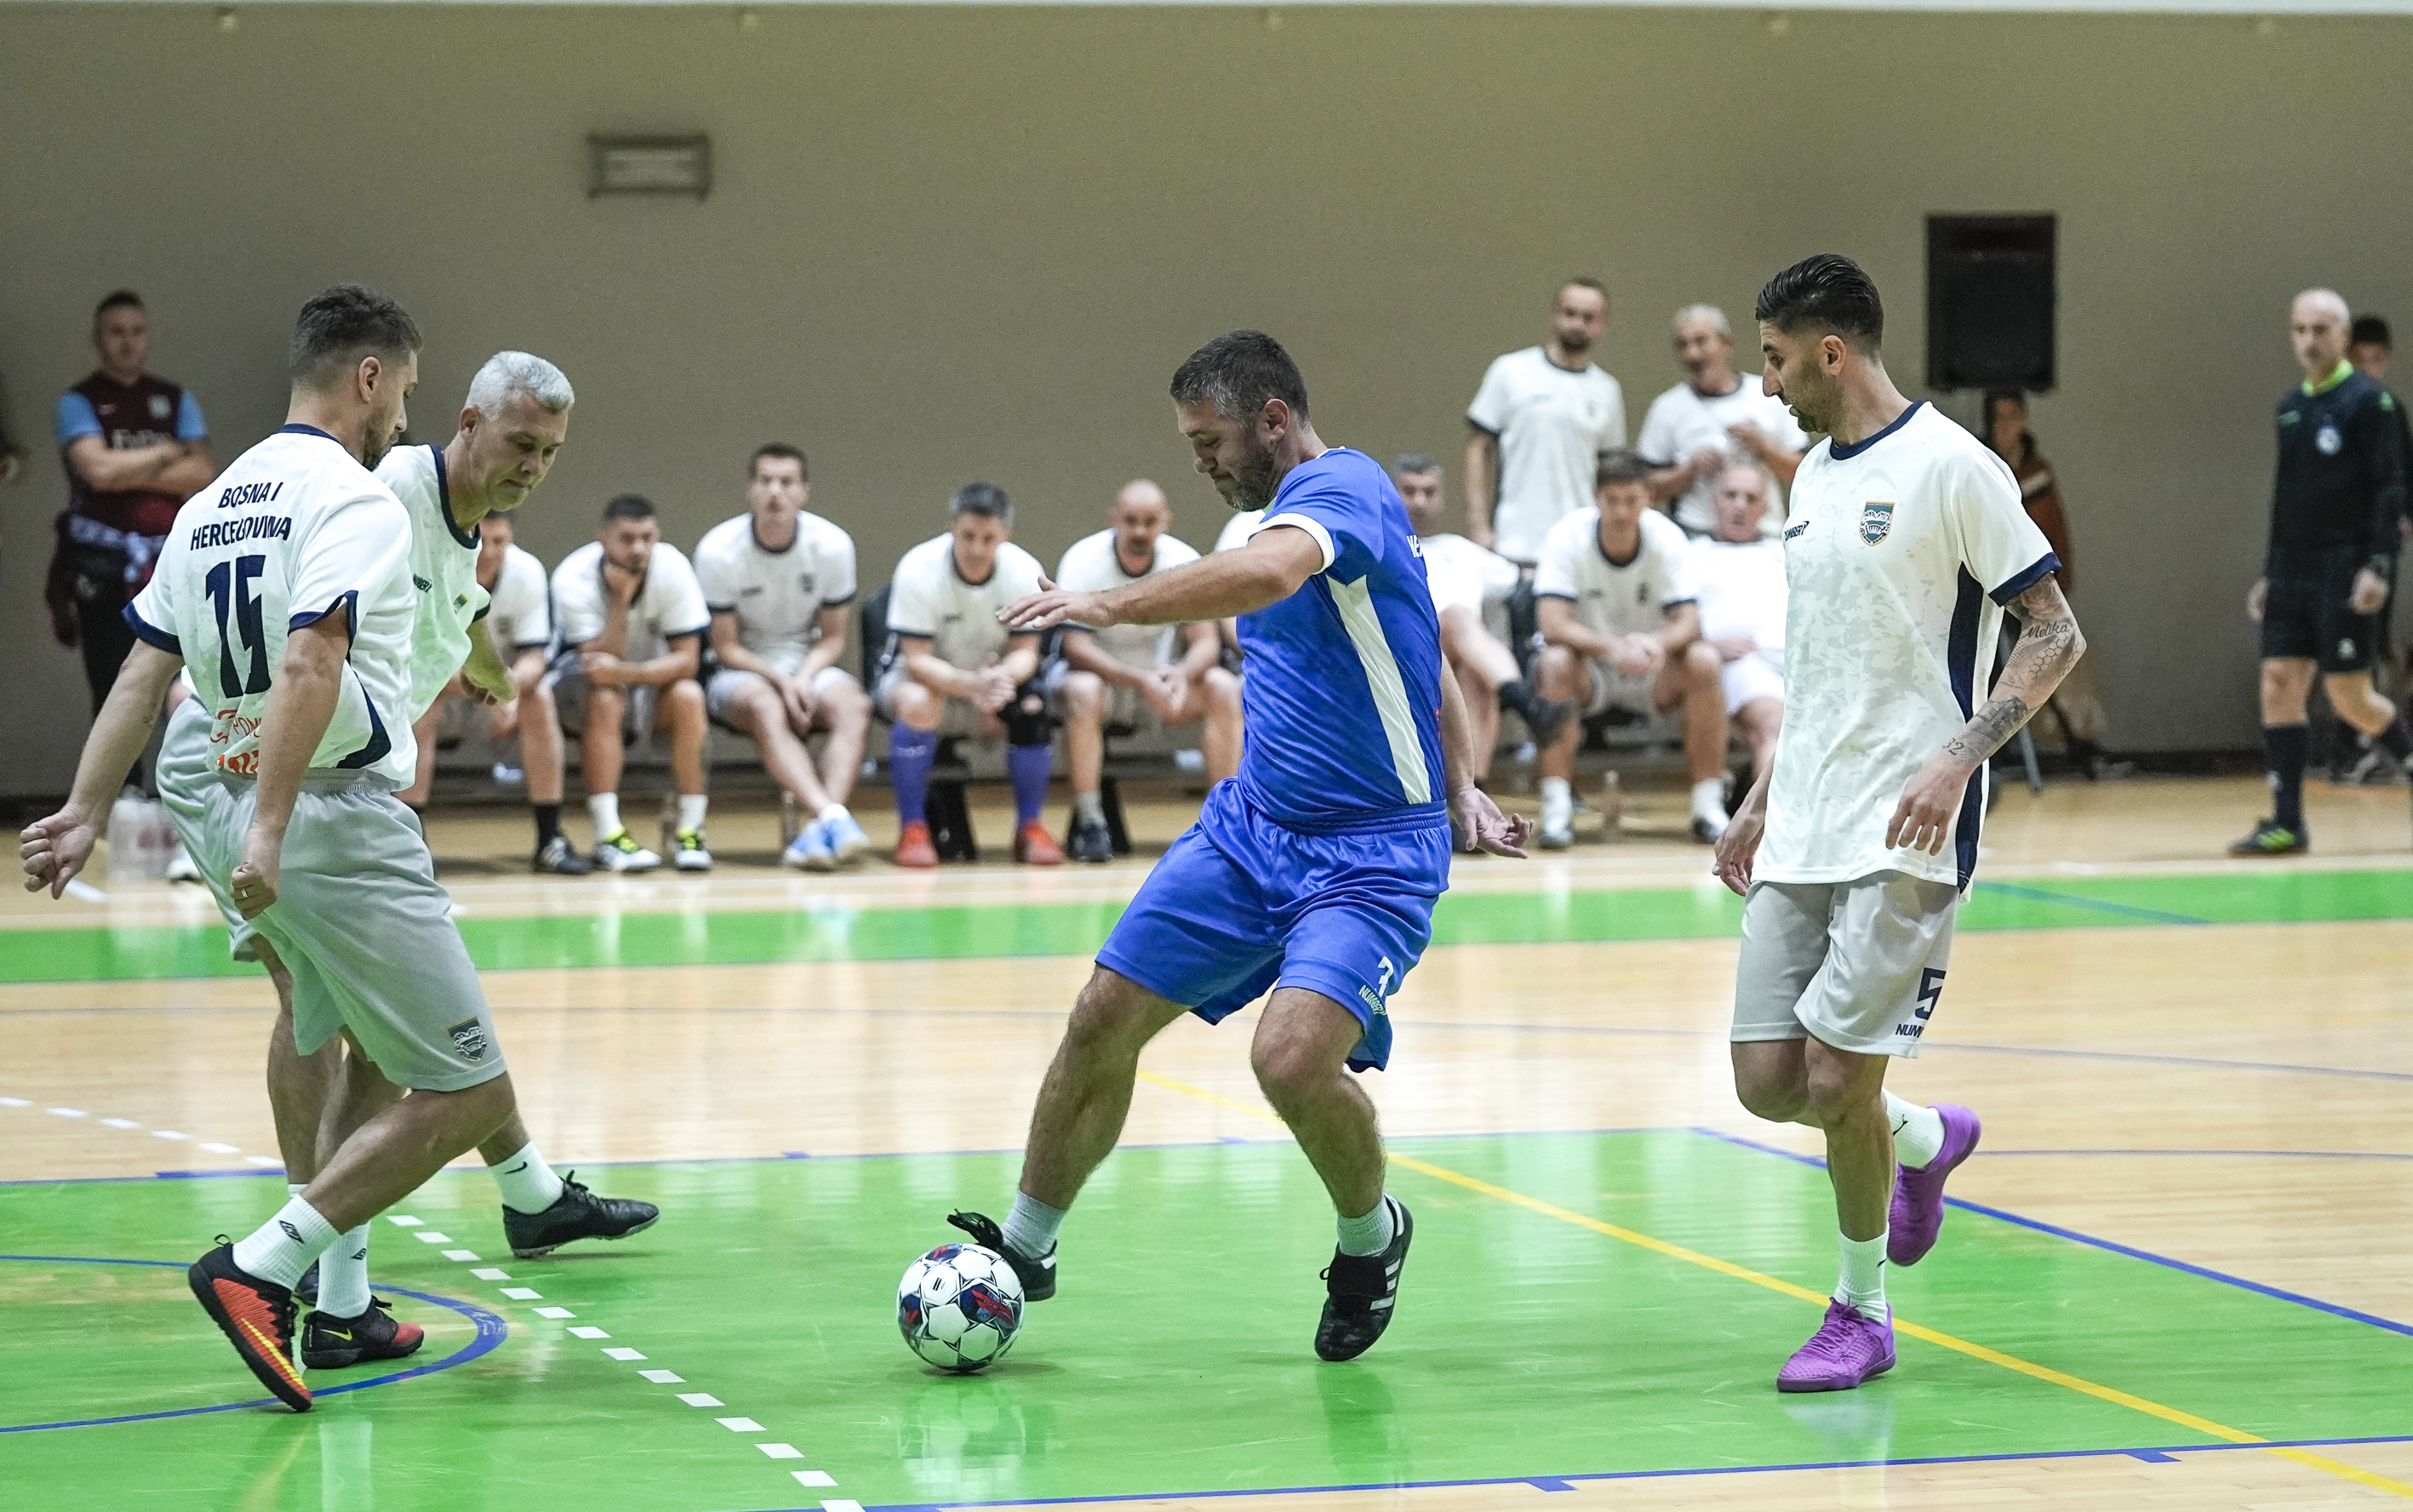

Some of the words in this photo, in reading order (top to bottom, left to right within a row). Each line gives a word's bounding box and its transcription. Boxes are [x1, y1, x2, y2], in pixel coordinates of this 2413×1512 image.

[218, 482, 272, 509] BOSNA
[270, 482, 283, 501] I
[190, 515, 292, 551] HERCEGOVINA
[205, 554, 272, 699] 15
[1914, 967, 1947, 1021] 5
